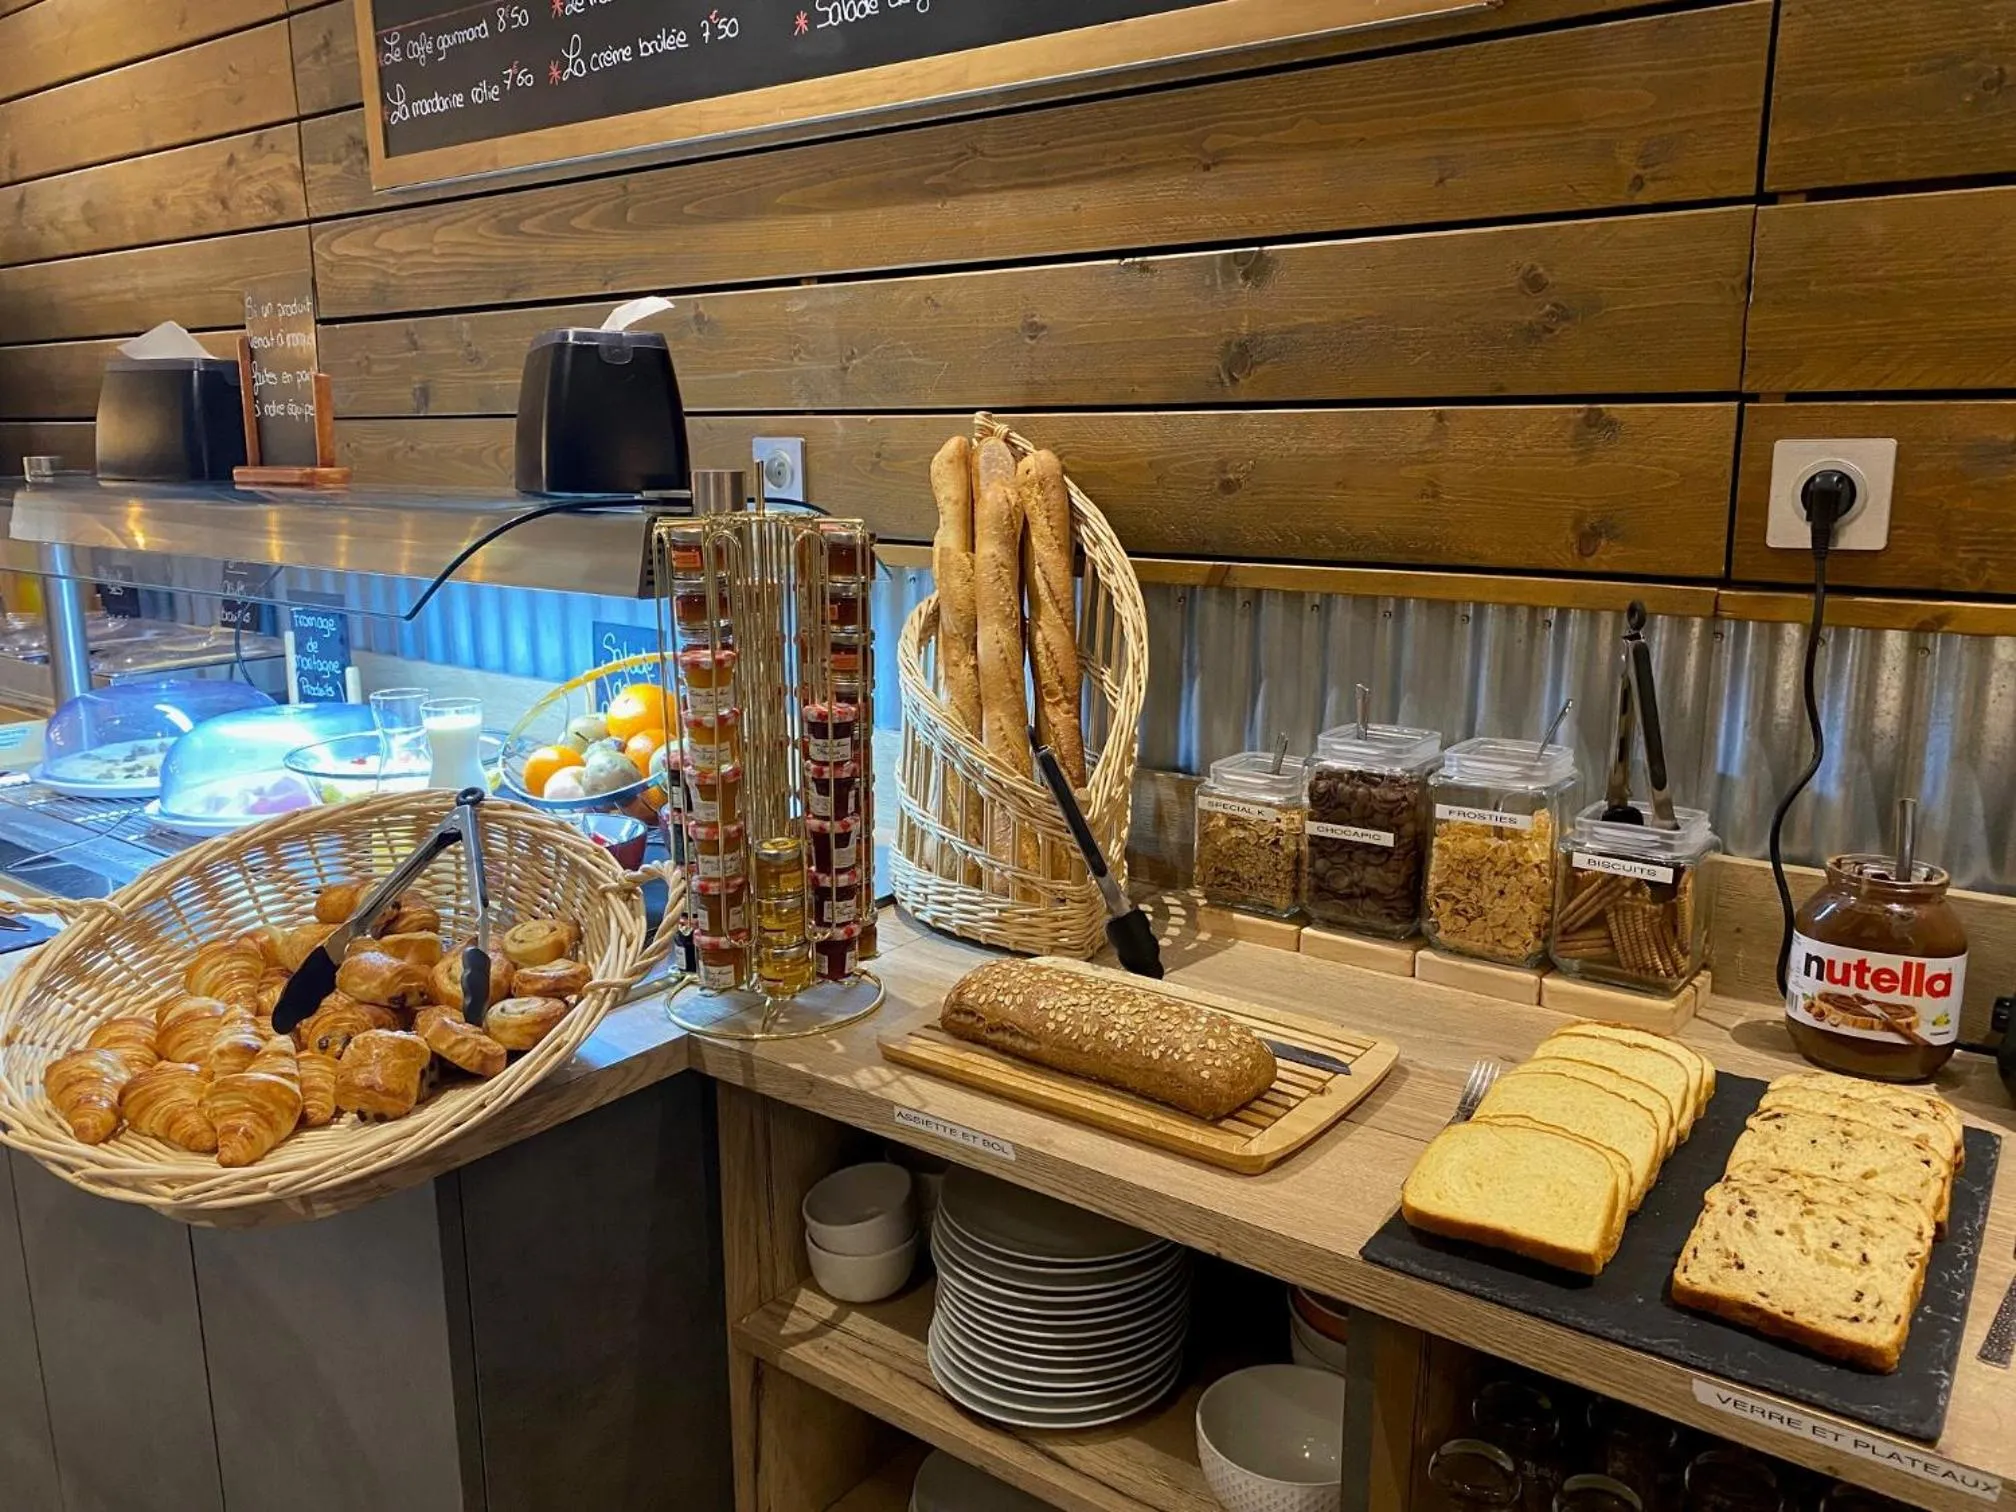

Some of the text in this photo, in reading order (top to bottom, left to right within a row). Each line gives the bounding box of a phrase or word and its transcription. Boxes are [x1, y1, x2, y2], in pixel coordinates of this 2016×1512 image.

[383, 31, 402, 65] Le
[407, 32, 433, 67] café
[561, 33, 586, 81] La
[589, 45, 632, 71] crème
[386, 83, 410, 125] La
[293, 610, 336, 637] Fromage
[306, 637, 319, 653] de
[1207, 800, 1265, 817] SPECIAL K
[1448, 809, 1518, 826] FROSTIES
[1316, 825, 1382, 841] CHOCAPIC
[1587, 857, 1657, 877] BISCUITS
[1803, 952, 1953, 999] nutella
[896, 1111, 1010, 1154] ASSIETTE ET BOL
[1716, 1392, 2000, 1496] VERRE ET PLATEAUX
